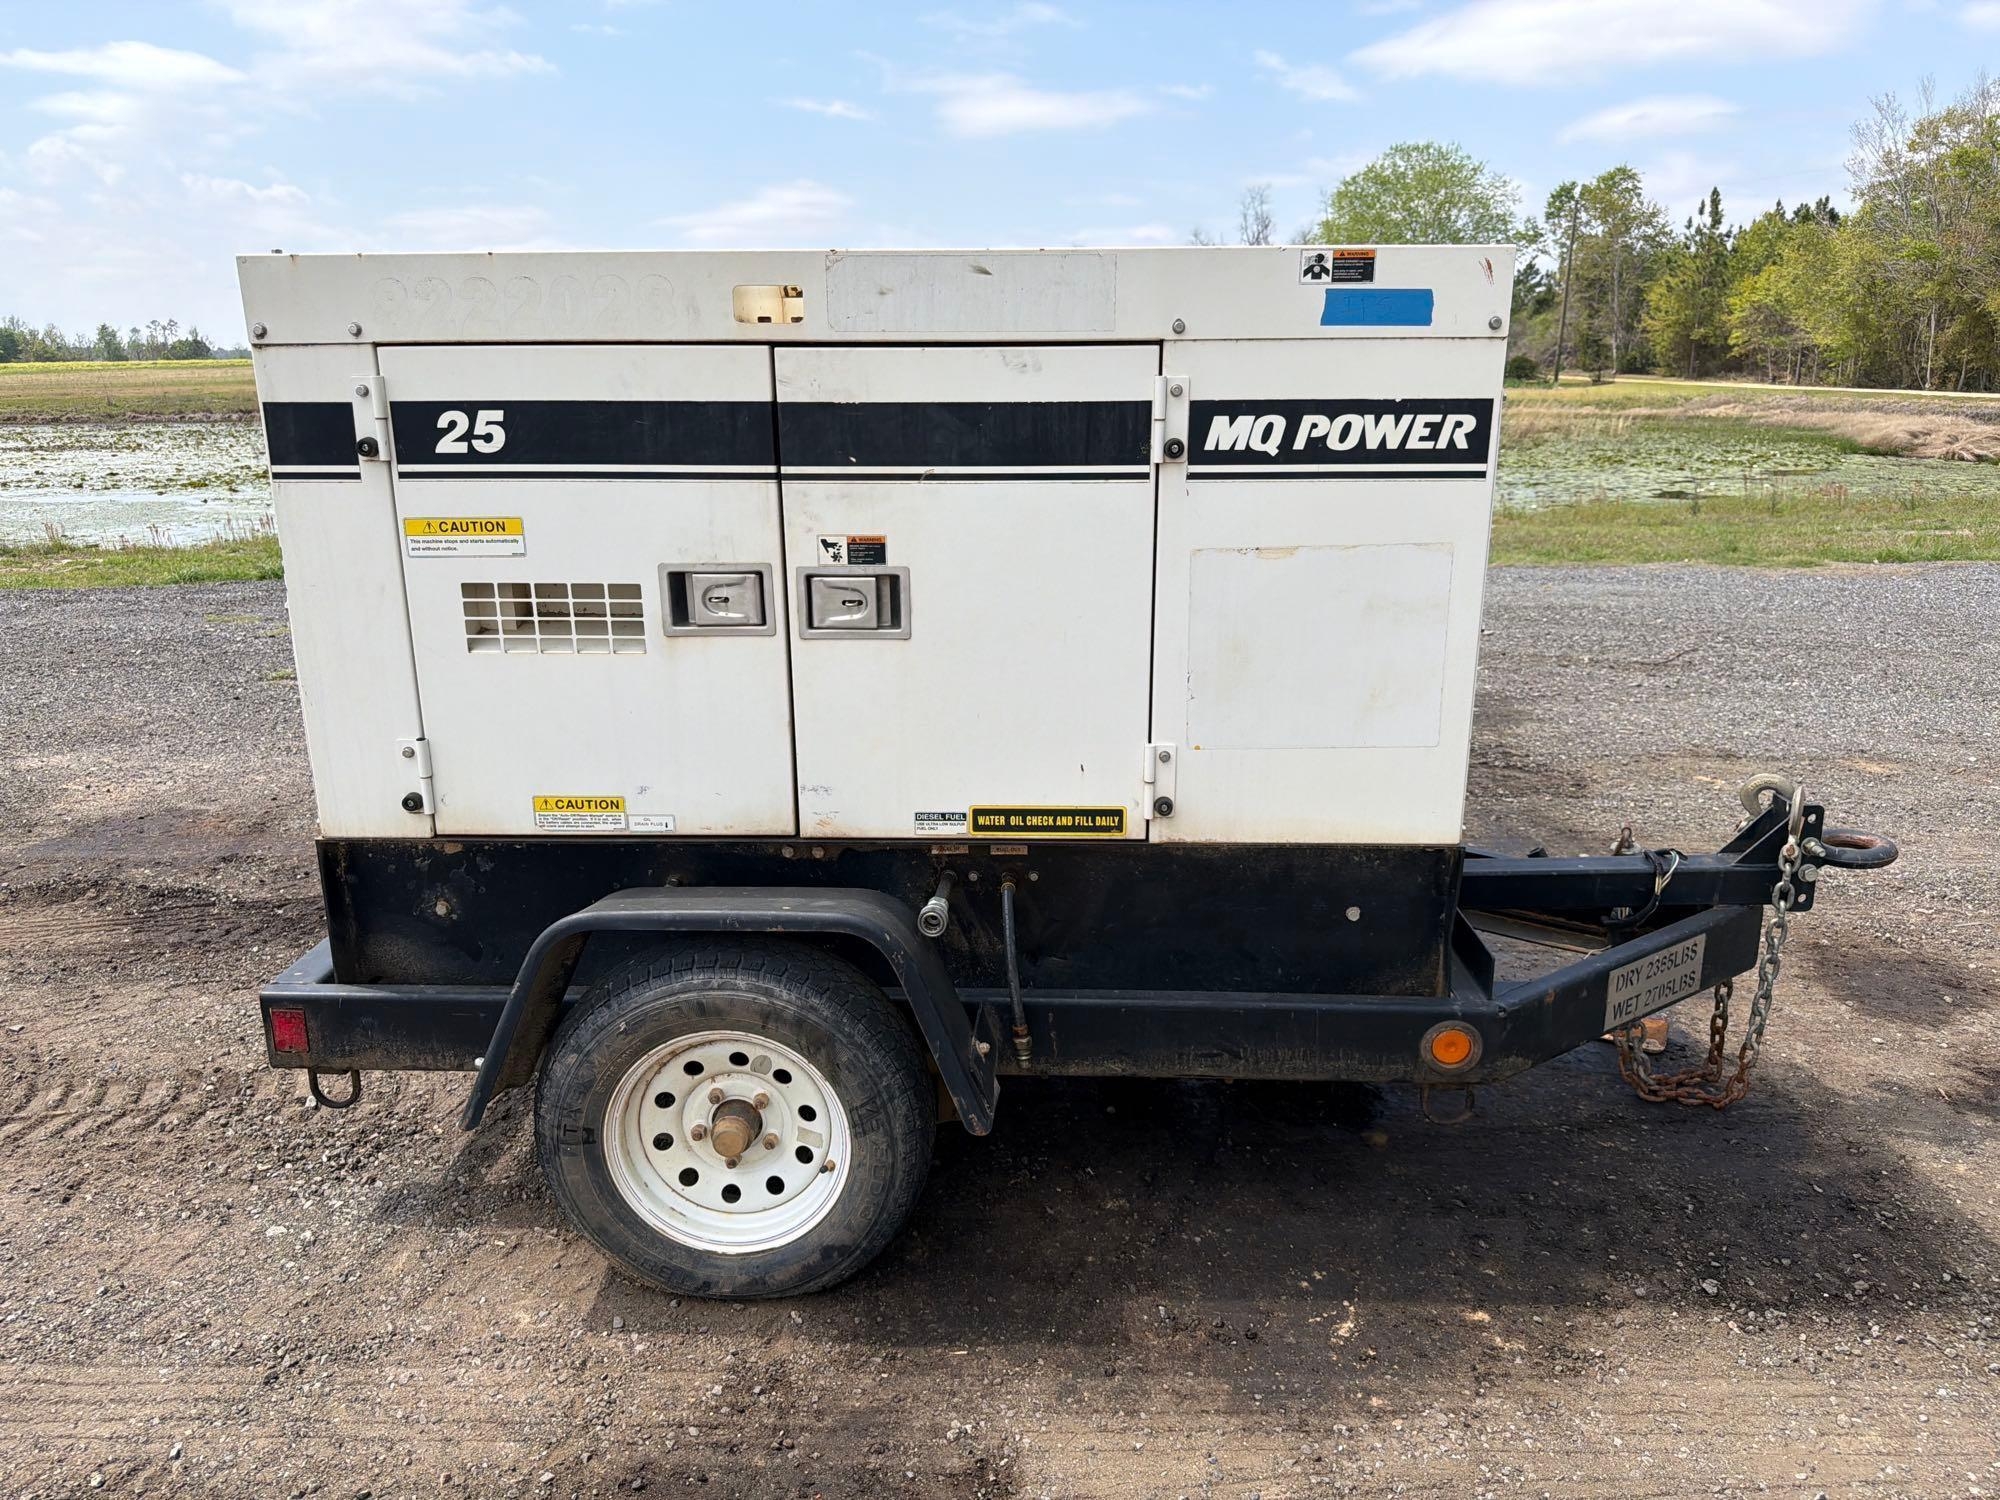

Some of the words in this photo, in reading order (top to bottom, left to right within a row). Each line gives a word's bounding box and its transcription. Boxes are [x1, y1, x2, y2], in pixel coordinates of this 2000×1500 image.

[435, 410, 505, 453] 25
[1203, 414, 1287, 457] MQ
[1292, 413, 1477, 451] POWER
[438, 521, 506, 533] CAUTION
[555, 799, 620, 810] CAUTION
[977, 815, 1005, 826] WATER
[1010, 815, 1025, 826] OIL
[1026, 815, 1054, 826] CHECK
[1056, 815, 1073, 826] AND
[1075, 815, 1094, 826] FILL
[1095, 815, 1120, 826] DAILY
[1615, 965, 1644, 993] DRY
[1613, 993, 1642, 1020] WET
[1643, 970, 1697, 1007] 2705LBS
